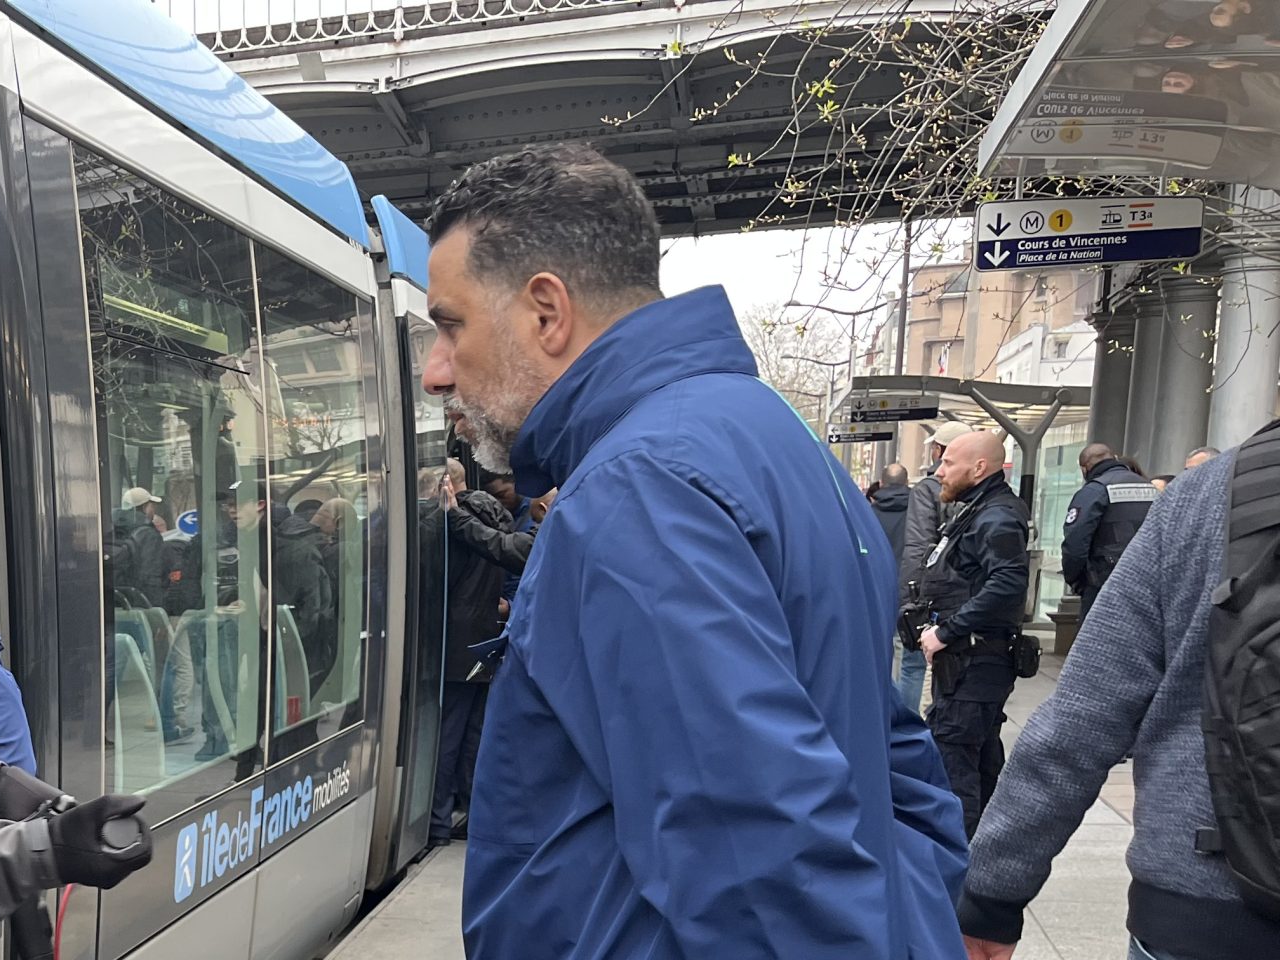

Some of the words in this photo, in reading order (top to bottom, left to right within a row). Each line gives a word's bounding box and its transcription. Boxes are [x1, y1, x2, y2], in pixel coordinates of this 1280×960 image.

[1129, 210, 1153, 222] T3a
[1017, 240, 1049, 251] Cours
[1052, 238, 1066, 249] de
[1069, 235, 1127, 247] Vincennes
[1019, 252, 1044, 262] Place
[1045, 251, 1057, 260] de
[1058, 250, 1067, 260] la
[1069, 249, 1101, 259] Nation
[312, 760, 350, 814] mobilités
